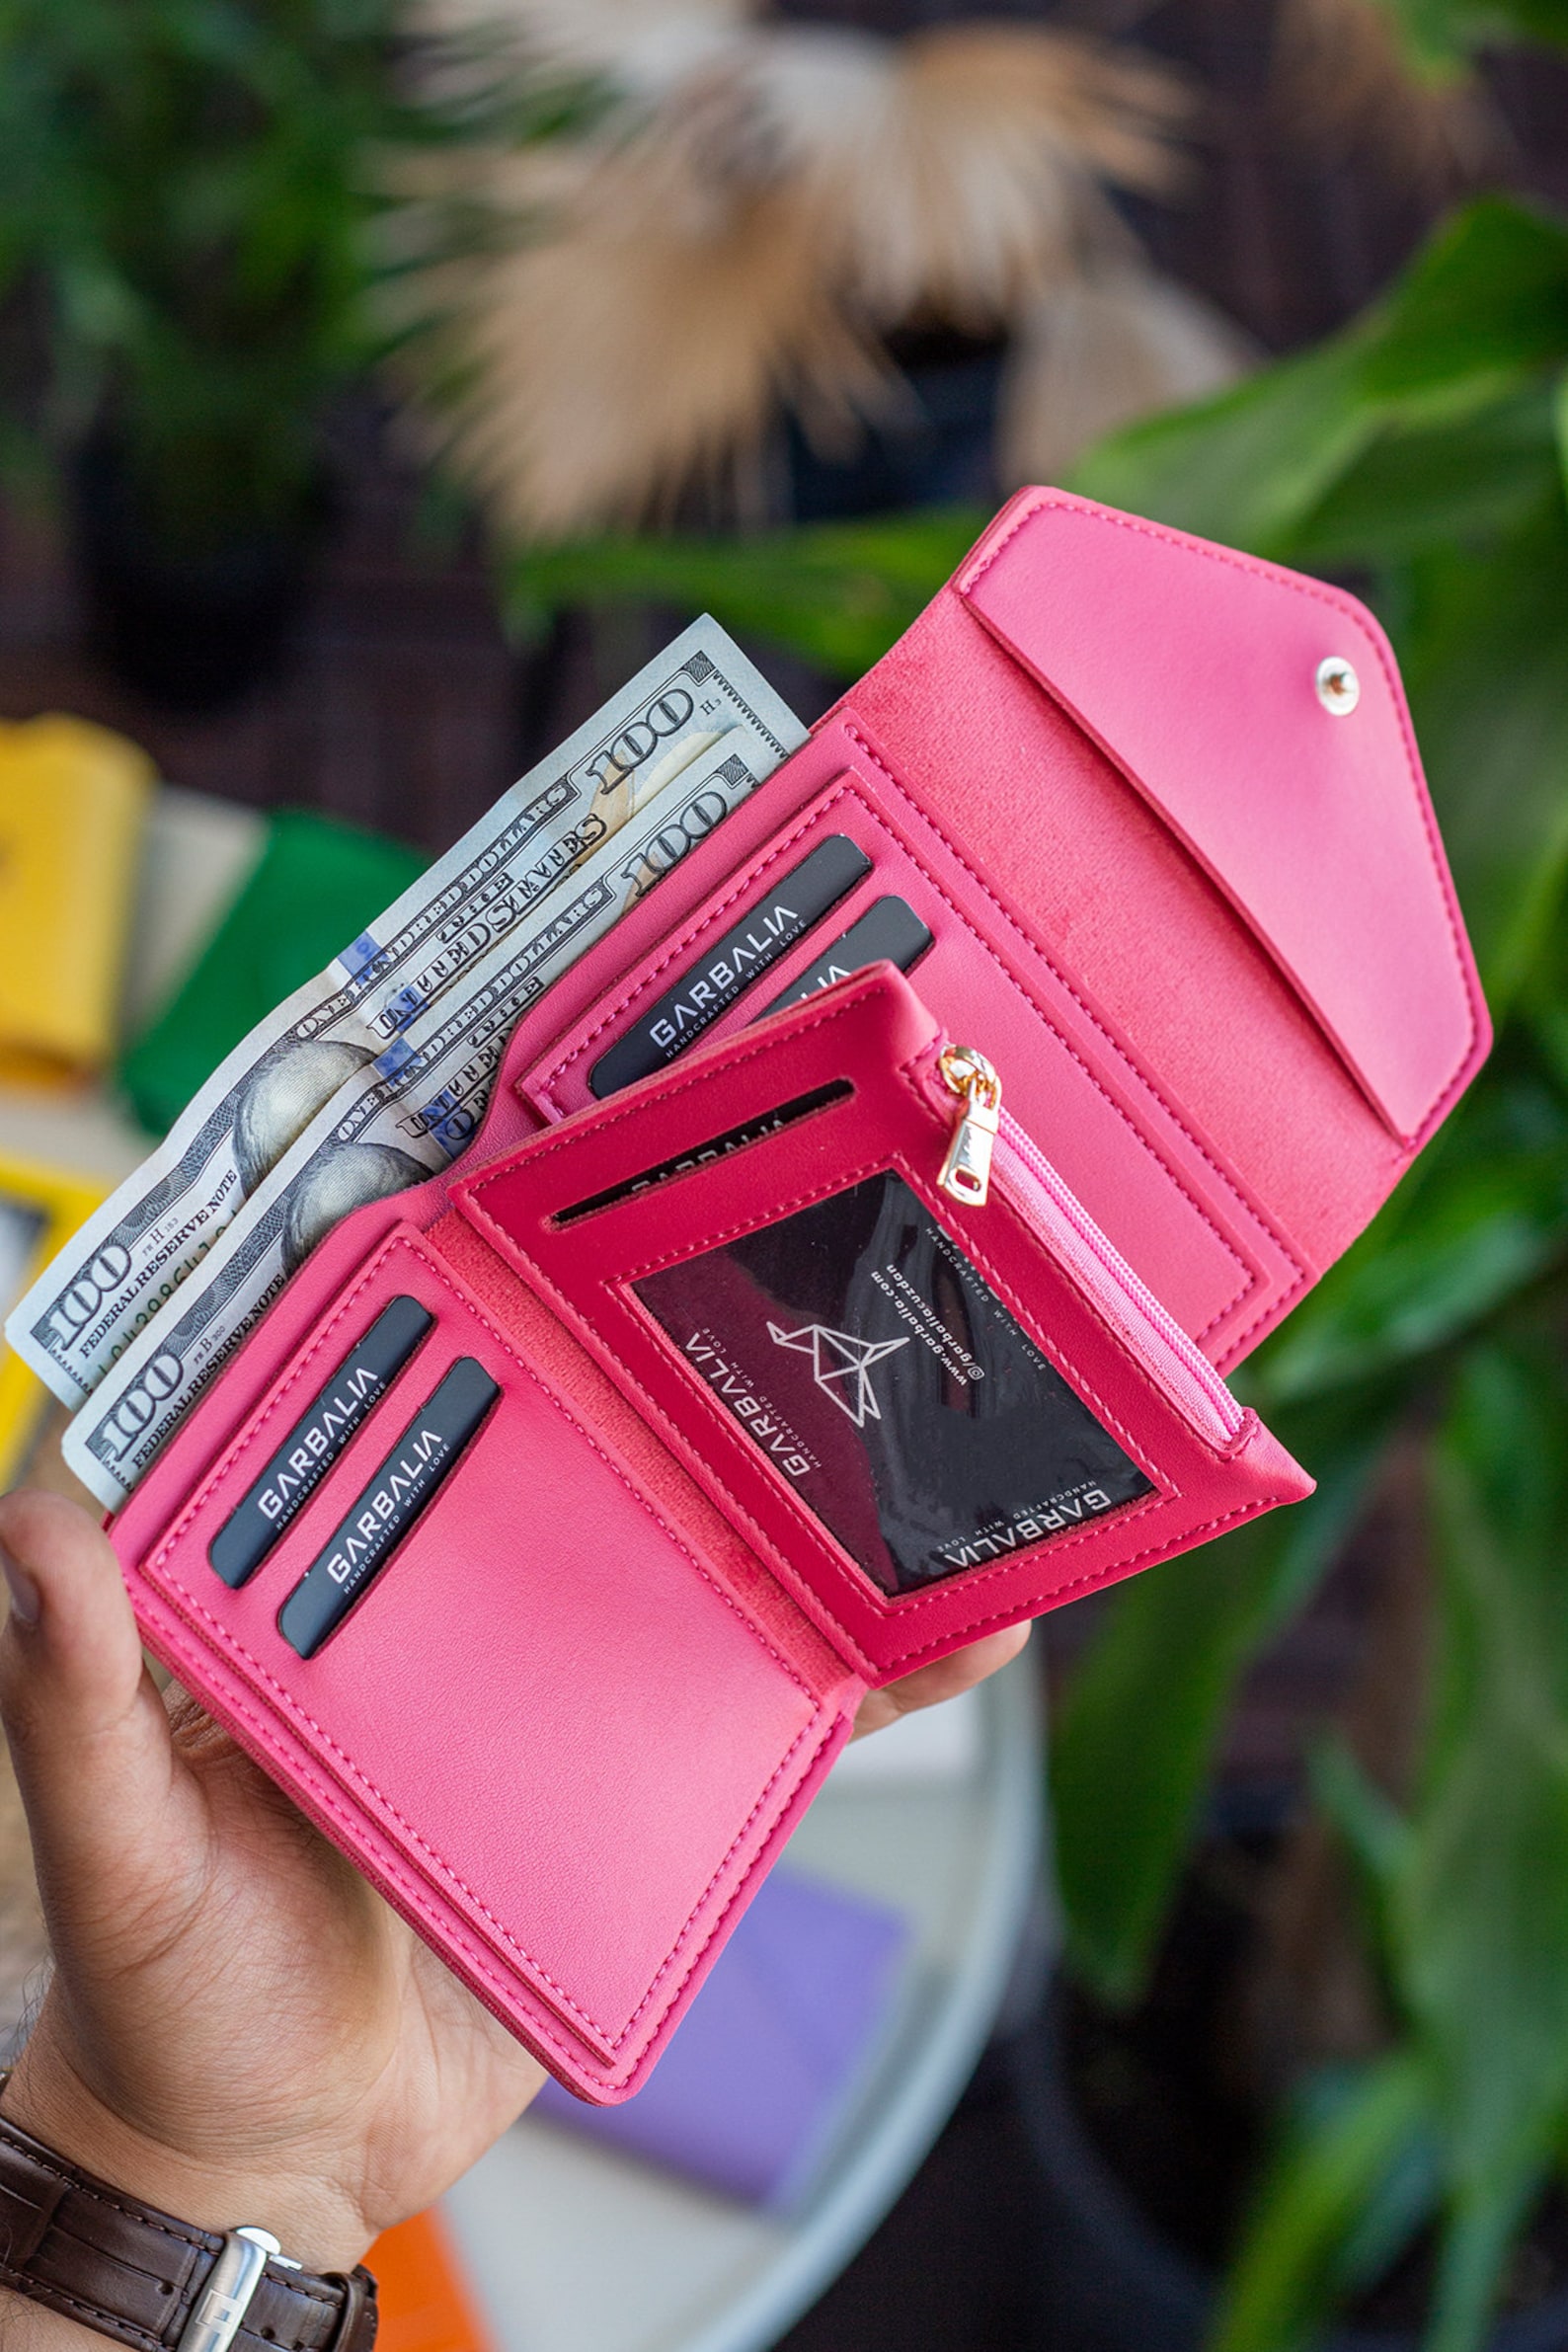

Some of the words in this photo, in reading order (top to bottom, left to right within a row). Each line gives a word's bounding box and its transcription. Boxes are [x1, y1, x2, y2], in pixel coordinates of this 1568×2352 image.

[586, 689, 694, 794] 100
[295, 991, 351, 1038] ONE
[348, 885, 464, 1000] HUNDRED
[460, 781, 572, 887] DOLLARS
[621, 791, 727, 897] 100
[366, 921, 492, 1039] UNITED
[491, 813, 607, 933] STATES
[649, 904, 799, 1049] GARBALIA
[666, 984, 741, 1059] HANDCRAFTED
[745, 952, 774, 980] WITH
[779, 919, 808, 948] LOVE
[337, 1087, 379, 1141] ONE
[379, 990, 496, 1099] HUNDRED
[492, 888, 603, 992] DOLLARS
[49, 1244, 132, 1351] 100
[79, 1282, 147, 1359] FEDERAL
[143, 1209, 210, 1287] RESERVE
[206, 1169, 238, 1215] NOTE
[871, 1270, 969, 1387] www.garbalia.com
[925, 1227, 990, 1303] HANDCRAFTED
[993, 1309, 1018, 1338] WITH
[1021, 1344, 1047, 1372] LOVE
[101, 1351, 185, 1462] 100
[132, 1390, 196, 1469] FEDERAL
[188, 1317, 256, 1395] RESERVE
[251, 1274, 285, 1320] NOTE
[685, 1332, 811, 1477] GARBALIA
[703, 1327, 728, 1355] LOVE
[730, 1362, 753, 1388] WITH
[258, 1367, 378, 1521] GARBALIA
[275, 1451, 335, 1530] HANDCRAFTED
[339, 1417, 360, 1445] WITH
[363, 1380, 386, 1409] LOVE
[760, 1394, 822, 1469] HANDCRAFTED
[1012, 1480, 1098, 1521] HANDCRAFTED
[327, 1430, 443, 1585] GARBALIA
[343, 1515, 401, 1595] HANDCRAFTED
[403, 1480, 426, 1508] WITH
[429, 1443, 450, 1472] LOVE
[936, 1535, 967, 1554] LOVE
[944, 1488, 1112, 1569] GARBALIA
[975, 1520, 1004, 1536] WITH
